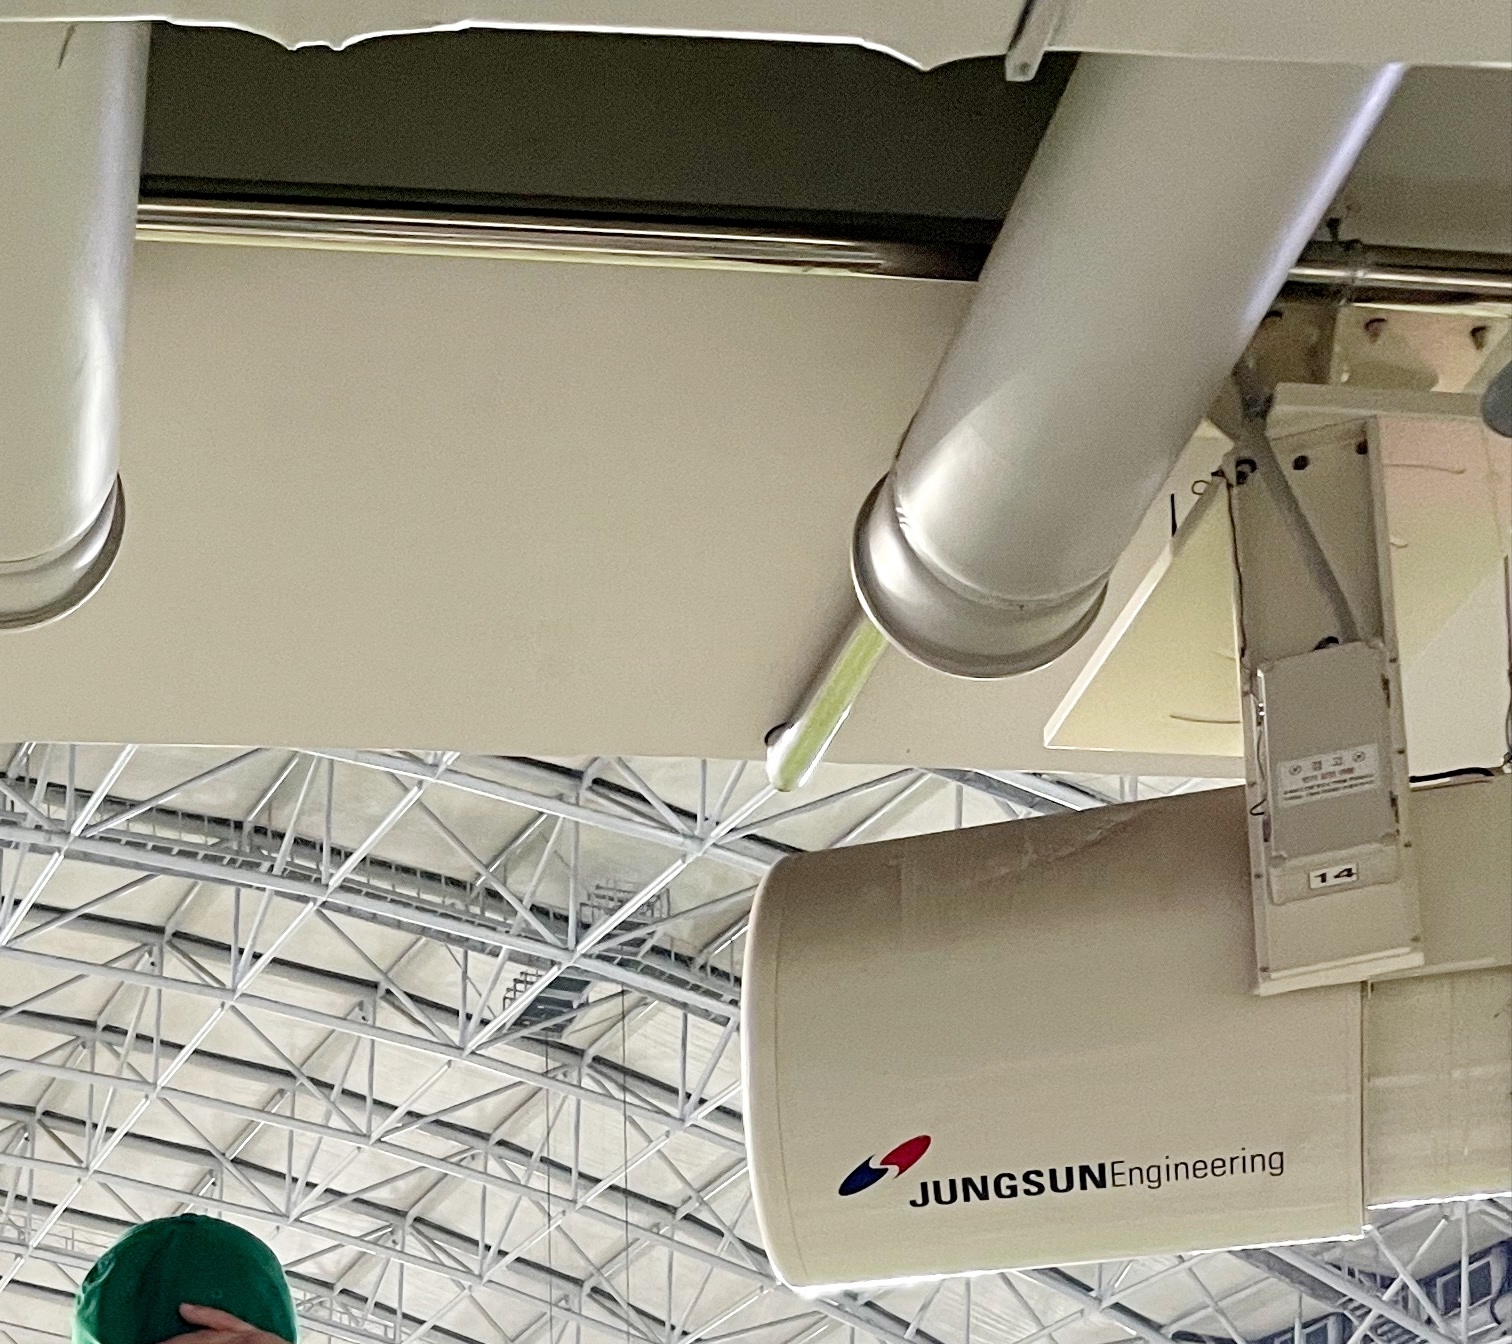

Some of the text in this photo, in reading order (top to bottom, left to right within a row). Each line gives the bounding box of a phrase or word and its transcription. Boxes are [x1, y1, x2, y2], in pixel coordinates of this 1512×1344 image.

[1314, 867, 1357, 884] 14
[909, 1147, 1285, 1208] JUNGSUN Engineering
